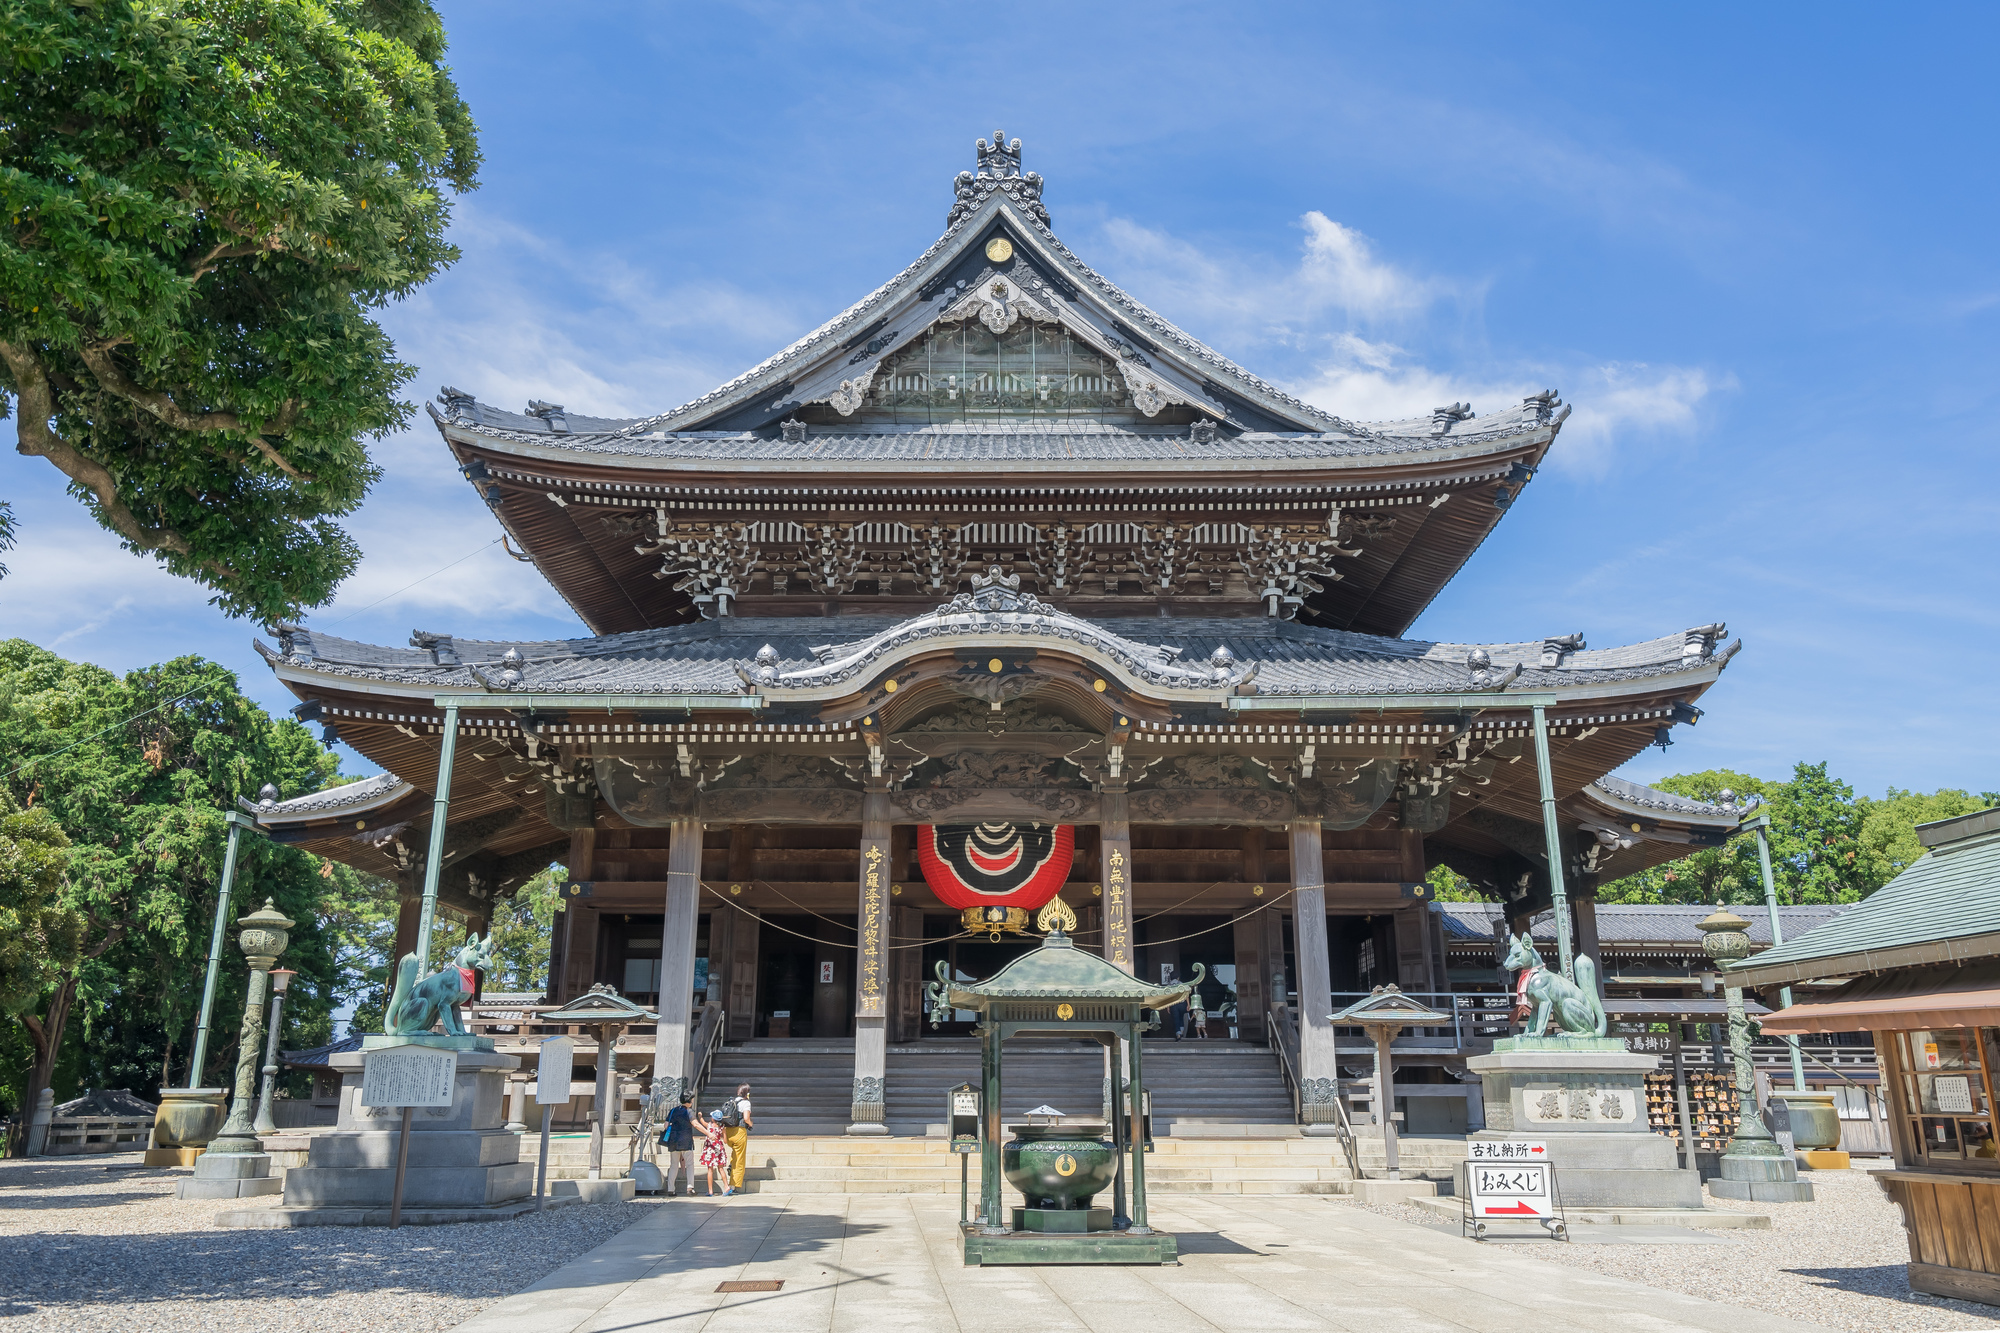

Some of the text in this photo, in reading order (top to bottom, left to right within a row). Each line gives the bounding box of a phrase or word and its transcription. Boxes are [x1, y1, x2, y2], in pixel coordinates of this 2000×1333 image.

[1472, 1143, 1529, 1157] 古札納所
[1482, 1171, 1539, 1191] おみくじ
